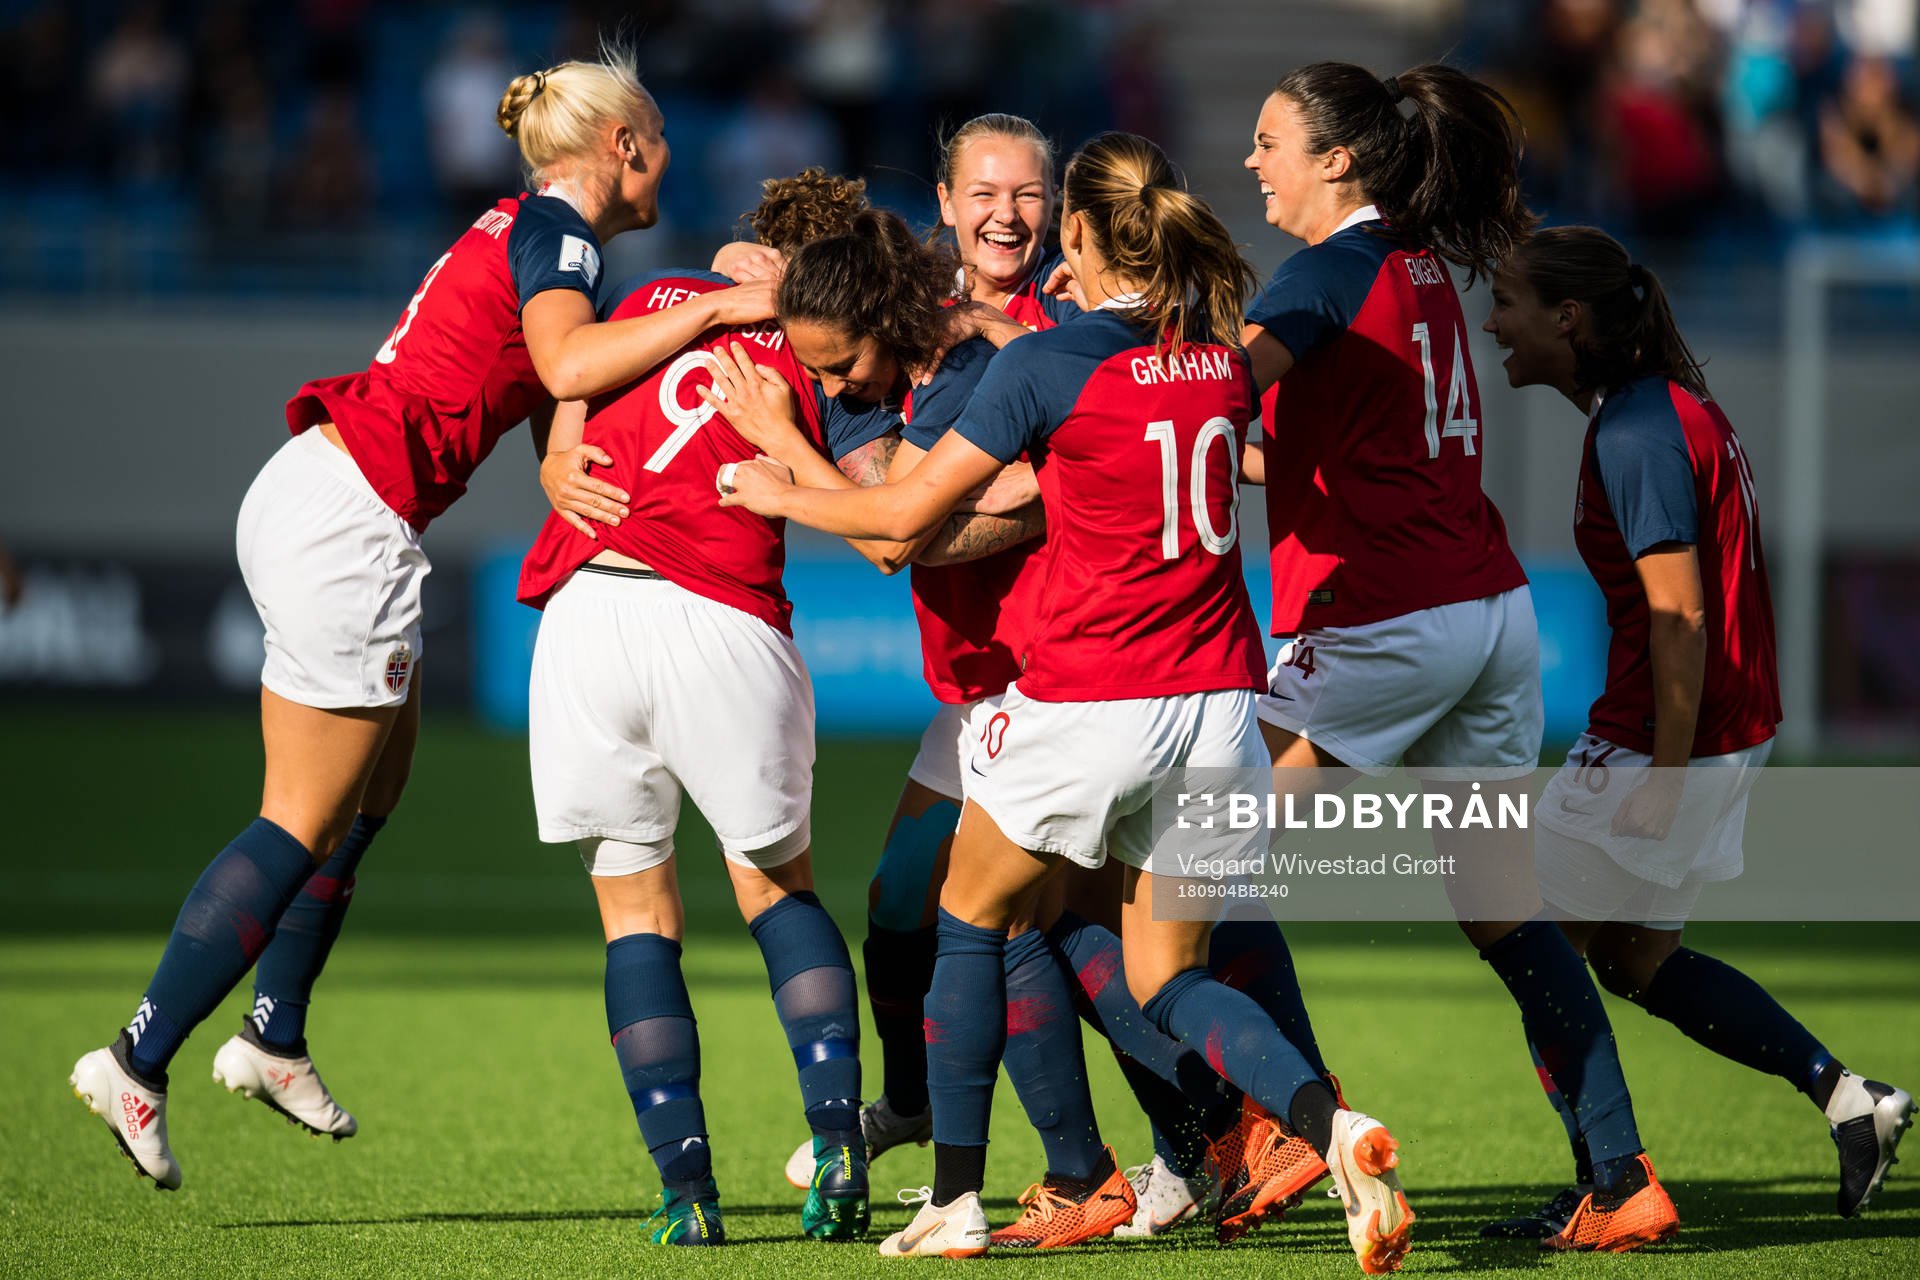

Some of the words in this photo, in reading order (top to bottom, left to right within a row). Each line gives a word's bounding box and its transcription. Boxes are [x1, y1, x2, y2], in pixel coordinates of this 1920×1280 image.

[1404, 256, 1445, 286] ENGEN
[1130, 351, 1233, 385] GRAHAM
[1411, 321, 1478, 459] 14
[643, 350, 730, 474] 9
[1143, 416, 1240, 560] 10
[121, 1091, 140, 1140] adidas
